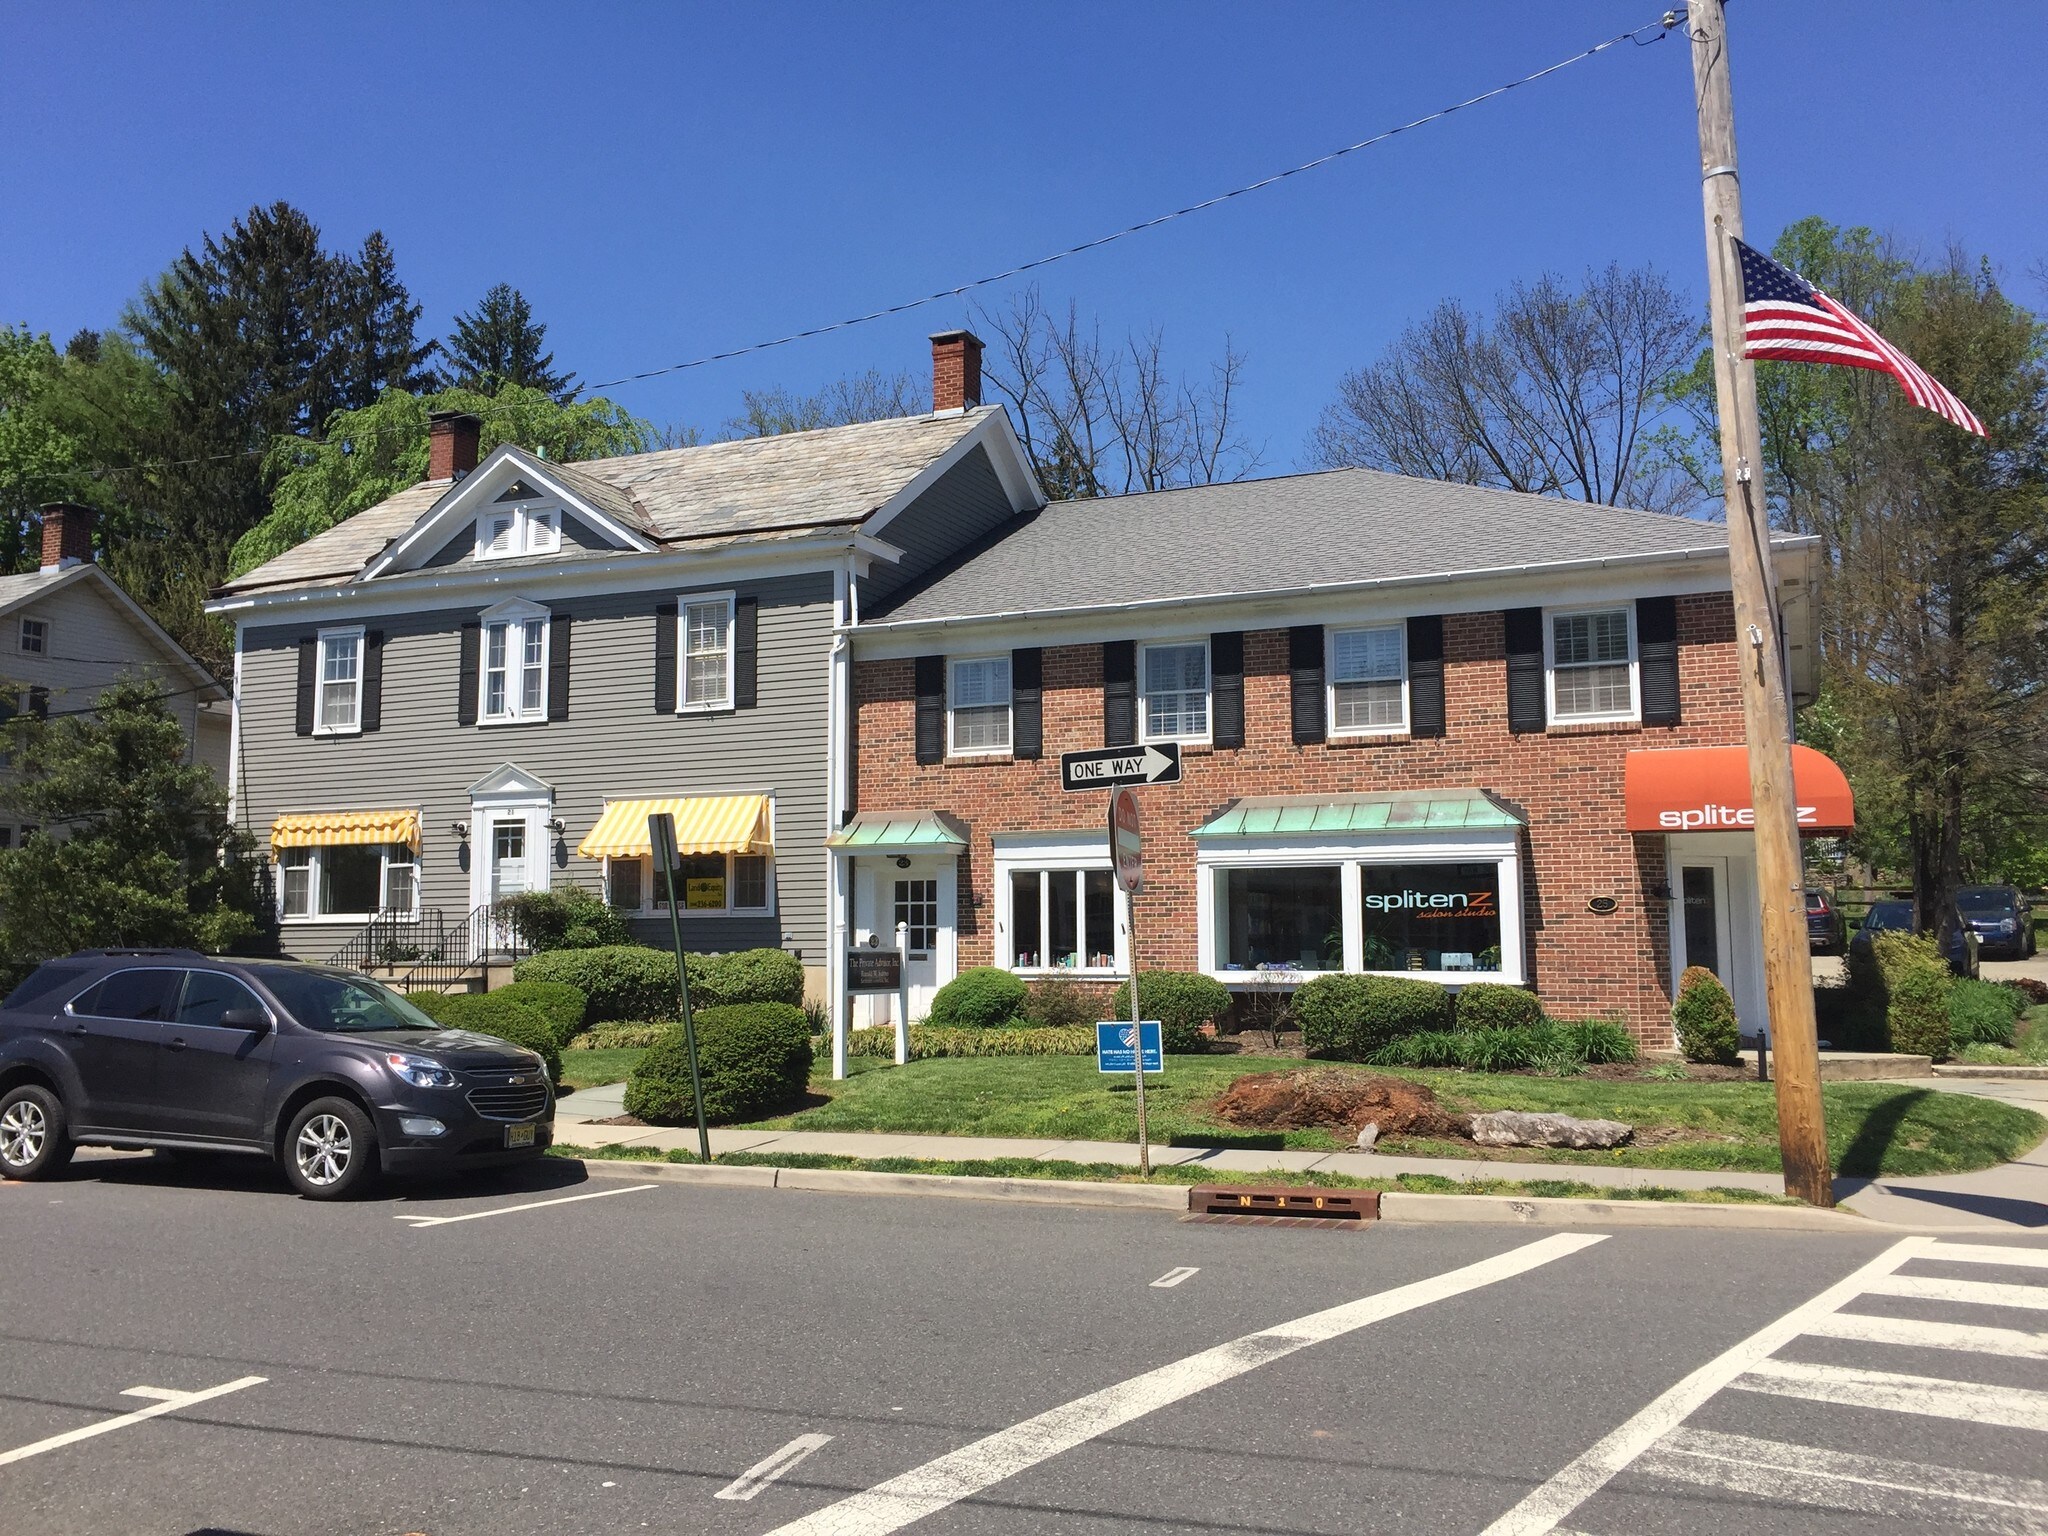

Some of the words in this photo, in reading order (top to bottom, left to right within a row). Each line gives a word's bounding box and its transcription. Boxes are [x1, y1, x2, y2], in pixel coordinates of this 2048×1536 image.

[1074, 762, 1104, 778] ONE
[1112, 758, 1143, 775] WAY
[1659, 804, 1817, 830] splitez
[1596, 899, 1608, 909] 25
[1416, 908, 1453, 919] salon
[1454, 906, 1497, 917] studio
[849, 958, 858, 968] The
[1240, 1196, 1250, 1206] N
